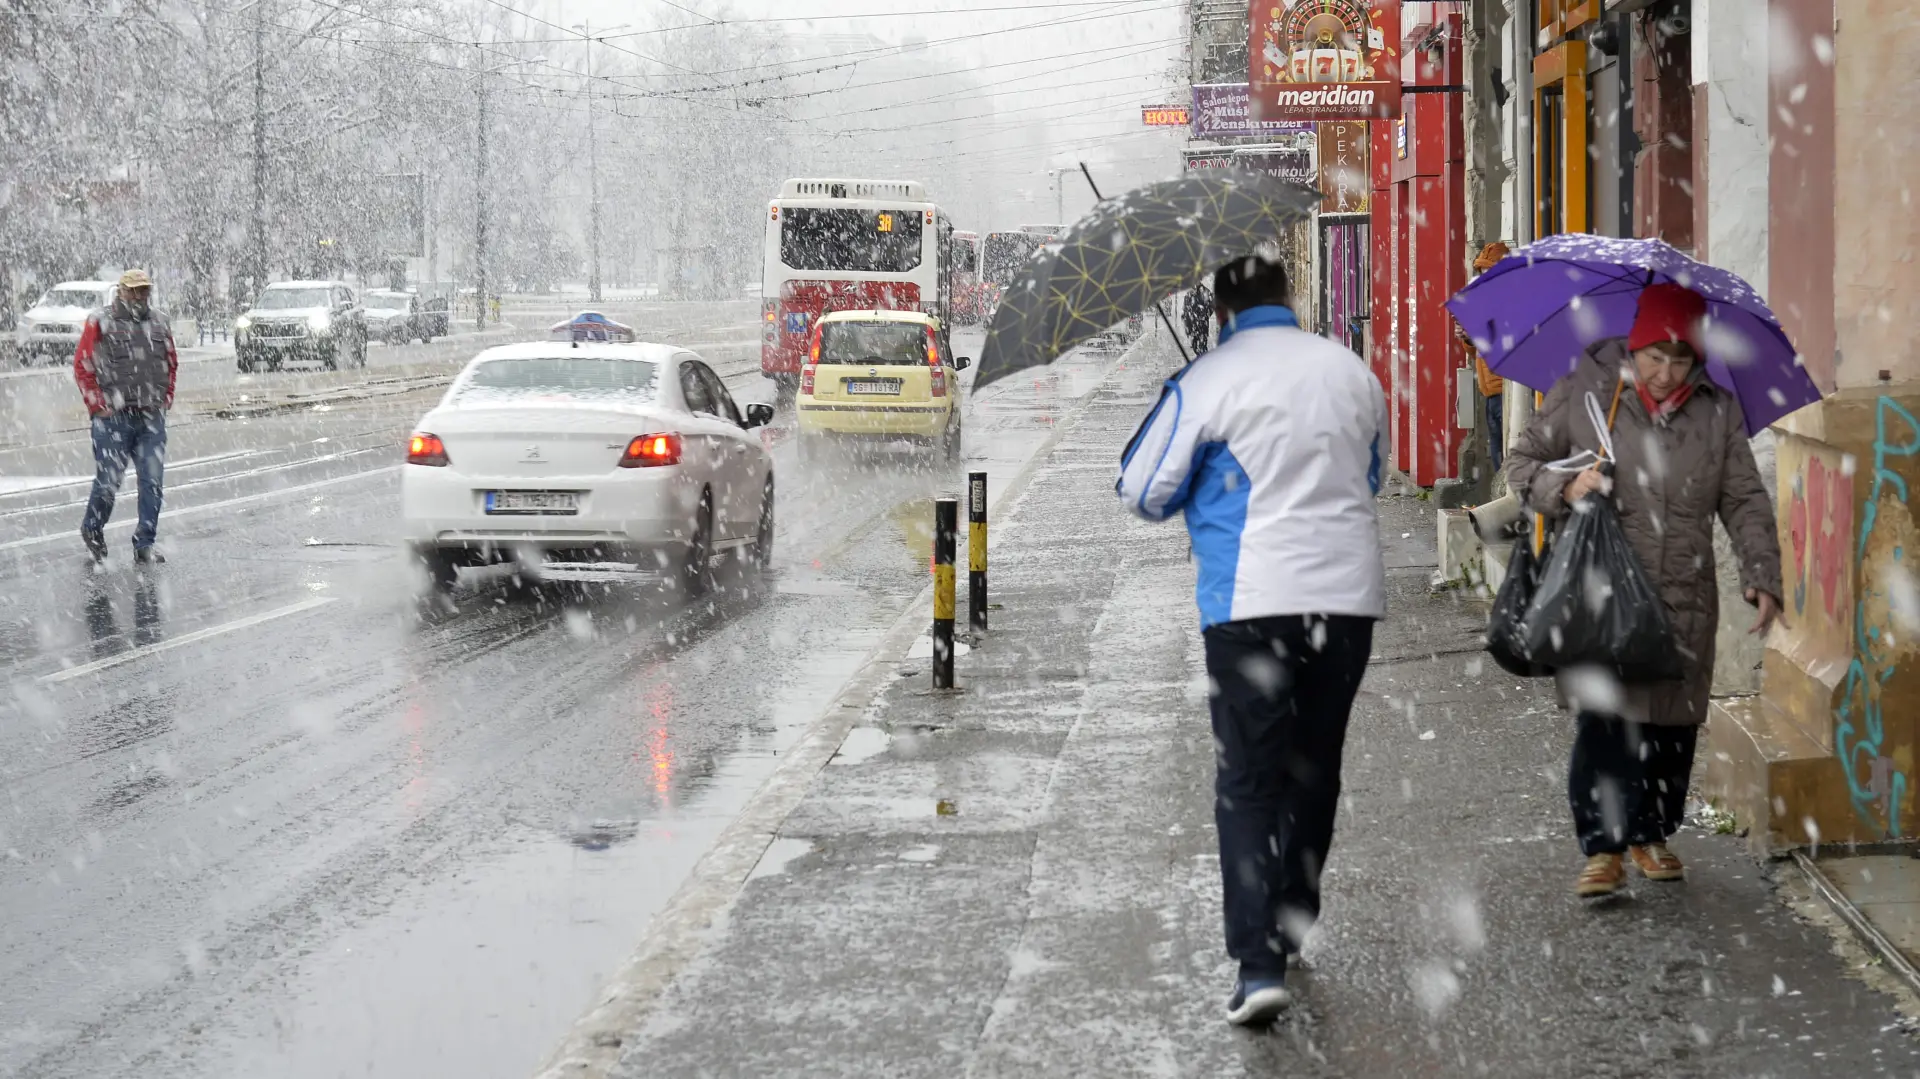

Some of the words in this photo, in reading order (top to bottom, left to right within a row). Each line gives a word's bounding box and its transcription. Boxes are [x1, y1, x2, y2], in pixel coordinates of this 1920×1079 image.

[1277, 84, 1375, 106] meridian
[1284, 106, 1304, 114] LEPA
[1306, 106, 1338, 114] STRANA
[1339, 104, 1368, 113] ŽIVOTA
[1336, 125, 1349, 209] PEKARA
